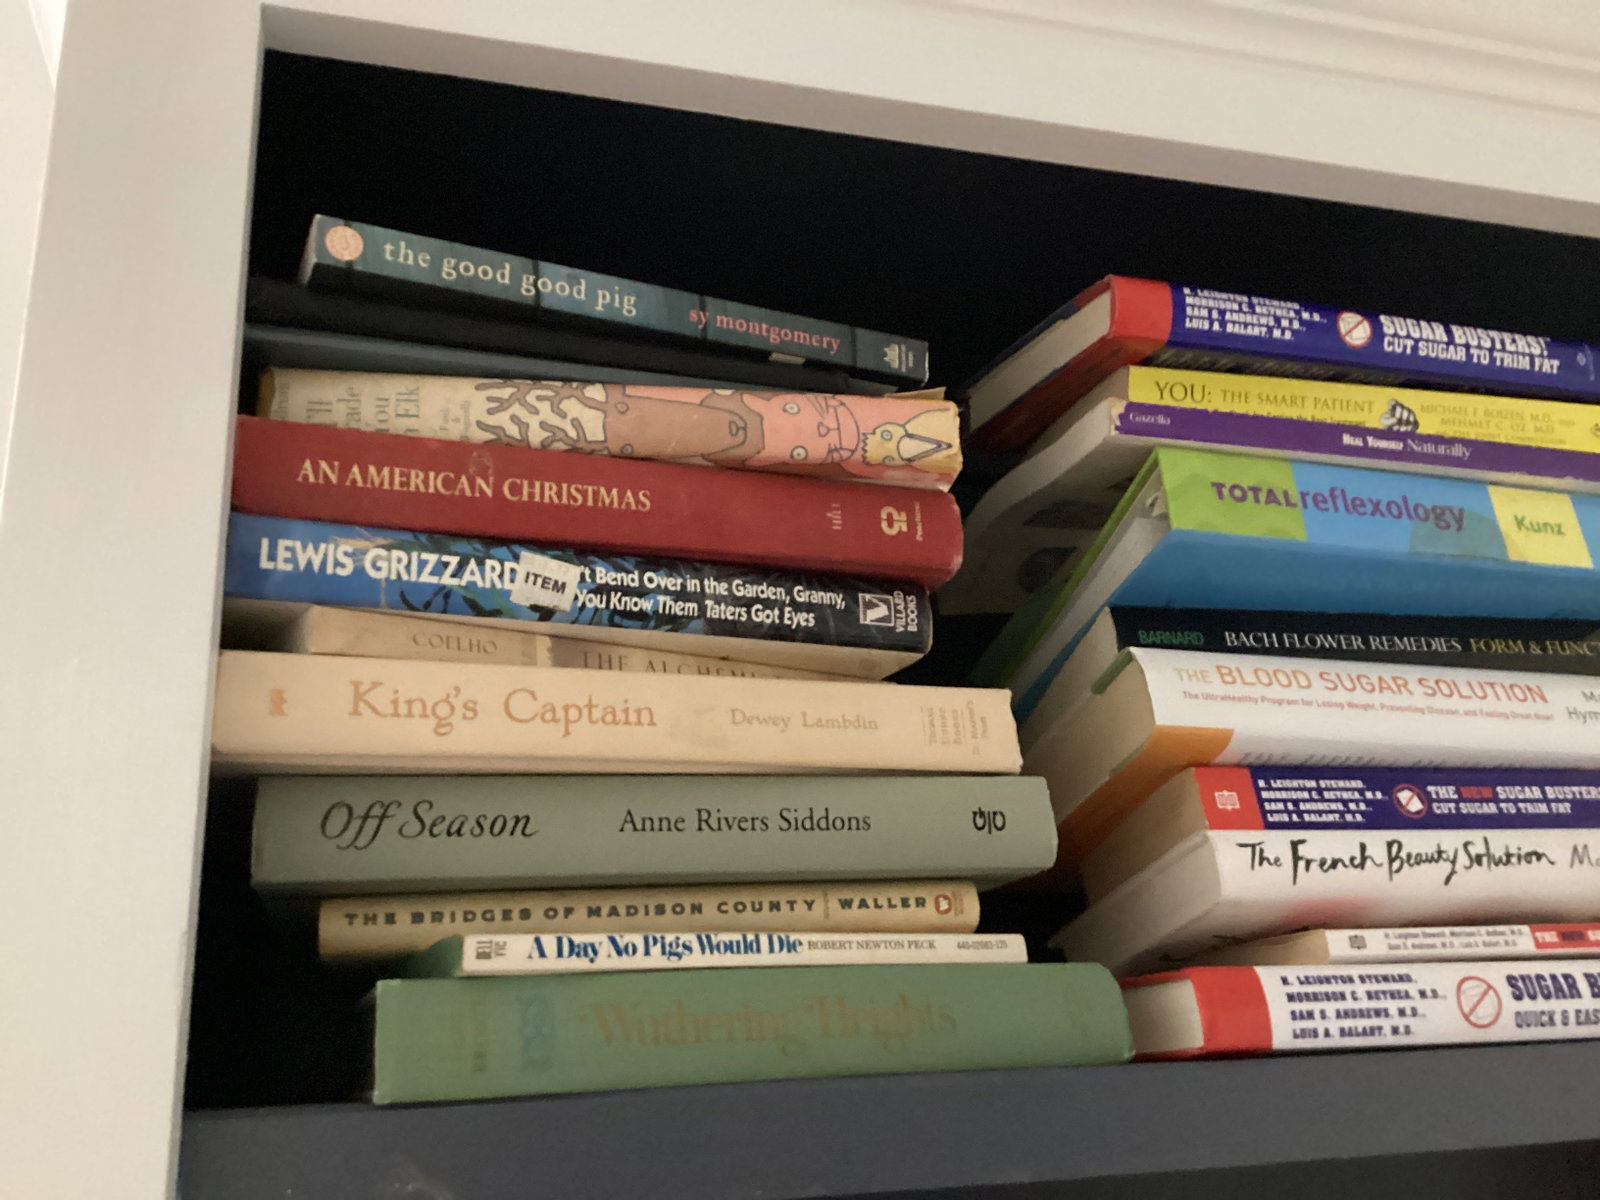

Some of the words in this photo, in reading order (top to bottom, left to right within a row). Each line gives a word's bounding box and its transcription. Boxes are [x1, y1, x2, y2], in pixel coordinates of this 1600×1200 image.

[384, 241, 430, 267] the
[441, 256, 511, 285] good
[520, 272, 587, 300] good
[595, 286, 637, 317] pig
[1185, 296, 1239, 311] MORRISON
[1186, 306, 1209, 319] SAM
[689, 309, 708, 328] sy
[716, 313, 840, 354] montgomery
[1185, 317, 1210, 330] LUIS
[1212, 320, 1223, 332] A.
[1379, 314, 1448, 342] SUGAR
[1383, 336, 1415, 355] CUT
[1418, 342, 1466, 362] SUGAR
[1470, 348, 1490, 365] TO
[1493, 351, 1531, 371] TRIM
[1534, 356, 1560, 374] FAT
[1155, 380, 1213, 403] YOU:
[1220, 389, 1251, 405] THE
[1257, 392, 1307, 410] SMART
[1313, 397, 1376, 415] PATIENT
[1406, 438, 1473, 460] Naturally
[296, 458, 340, 484] AN
[345, 463, 494, 498] AMERICAN
[502, 477, 652, 512] CHRISTMAS
[1210, 482, 1299, 508] TOTAL
[1299, 486, 1466, 533] reflexology
[1514, 514, 1566, 536] Kunz
[259, 537, 354, 576] LEWIS
[363, 547, 520, 590] GRIZZARD
[524, 571, 567, 595] ITEM
[595, 566, 639, 588] Bend
[643, 571, 683, 592] Over
[686, 574, 701, 593] in
[704, 576, 728, 595] the
[732, 579, 790, 605] Garden,
[793, 586, 846, 610] Granny,
[576, 588, 607, 609] You
[609, 591, 653, 612] Know
[656, 594, 698, 617] Them
[704, 599, 748, 621] Taters
[751, 603, 780, 624] Got
[783, 607, 816, 629] Eyes
[906, 594, 918, 632] BOOKS
[412, 632, 498, 655] COELHO
[1138, 630, 1205, 646] BARNARD
[1224, 631, 1279, 648] BACH
[1282, 632, 1366, 651] FLOWER
[1369, 635, 1462, 652] REMEDIES
[1469, 638, 1525, 654] FORM
[1529, 640, 1543, 655] &
[1173, 667, 1213, 684] THE
[1215, 664, 1313, 690] BLOOD
[1318, 671, 1414, 696] SUGAR
[1417, 677, 1549, 704] SOLUTION
[348, 680, 479, 736] King's
[503, 687, 658, 738] Captain
[730, 708, 791, 733] Dewey
[800, 711, 879, 731] Lambdin
[1426, 785, 1459, 799] THE
[1495, 785, 1544, 800] SUGAR
[1264, 802, 1285, 811] SAM
[1267, 813, 1290, 822] LUIS
[1431, 802, 1457, 814] CUT
[1459, 802, 1499, 814] SUGAR
[1499, 802, 1517, 814] TO
[1517, 802, 1550, 814] TRIM
[1551, 802, 1573, 814] FAT
[320, 799, 402, 851] Off
[398, 799, 539, 840] Season
[618, 807, 687, 833] Anne
[695, 807, 770, 833] Rivers
[778, 807, 872, 833] Siddons
[1236, 841, 1283, 871] The
[1290, 839, 1384, 885] French
[1386, 839, 1460, 886] Beauty
[1463, 836, 1557, 872] Solution
[344, 911, 397, 926] THE
[410, 907, 532, 925] BRIDGES
[543, 906, 575, 920] OF
[587, 901, 704, 919] MADISON
[716, 899, 816, 915] COUNTY
[837, 896, 927, 911] WALLER
[526, 935, 548, 960] A
[555, 935, 602, 963] Day
[607, 934, 638, 959] No
[642, 934, 693, 961] Pigs
[695, 933, 761, 956] Would
[767, 933, 803, 955] Die
[807, 939, 854, 951] ROBERT
[856, 939, 905, 950] NEWTON
[907, 939, 936, 950] PECK
[1505, 973, 1583, 1001] SUGAR
[1290, 1009, 1316, 1021] SAM
[1514, 1010, 1557, 1028] QUICK
[1292, 1027, 1319, 1040] LUIS
